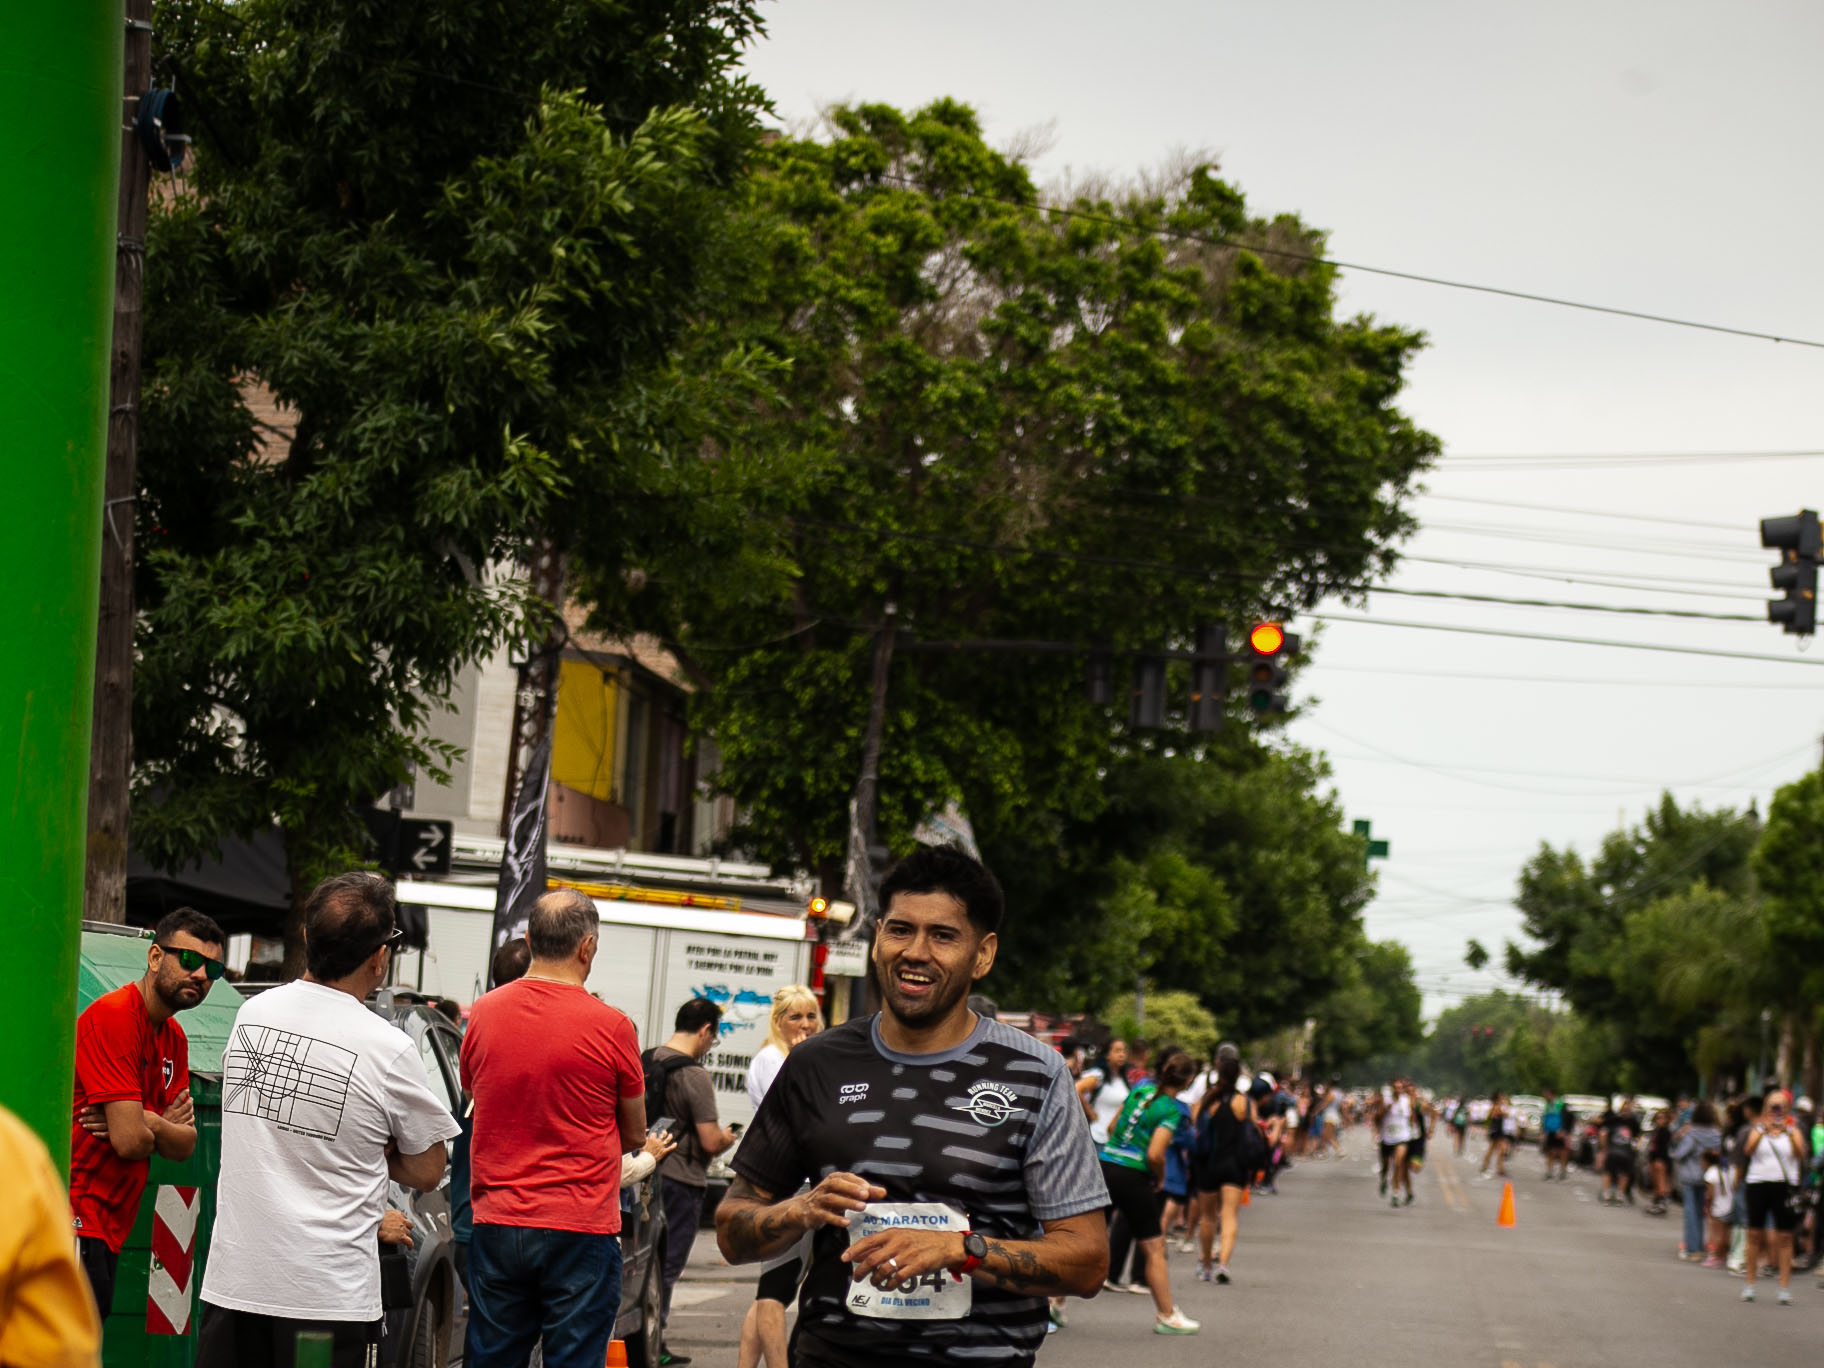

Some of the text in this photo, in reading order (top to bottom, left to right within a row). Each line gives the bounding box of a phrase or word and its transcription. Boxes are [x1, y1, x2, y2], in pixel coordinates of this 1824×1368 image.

[717, 1053, 752, 1070] SOMO
[839, 1093, 867, 1104] graph
[967, 1082, 1018, 1102] RUNNING TEAM
[880, 1215, 949, 1225] MARATON
